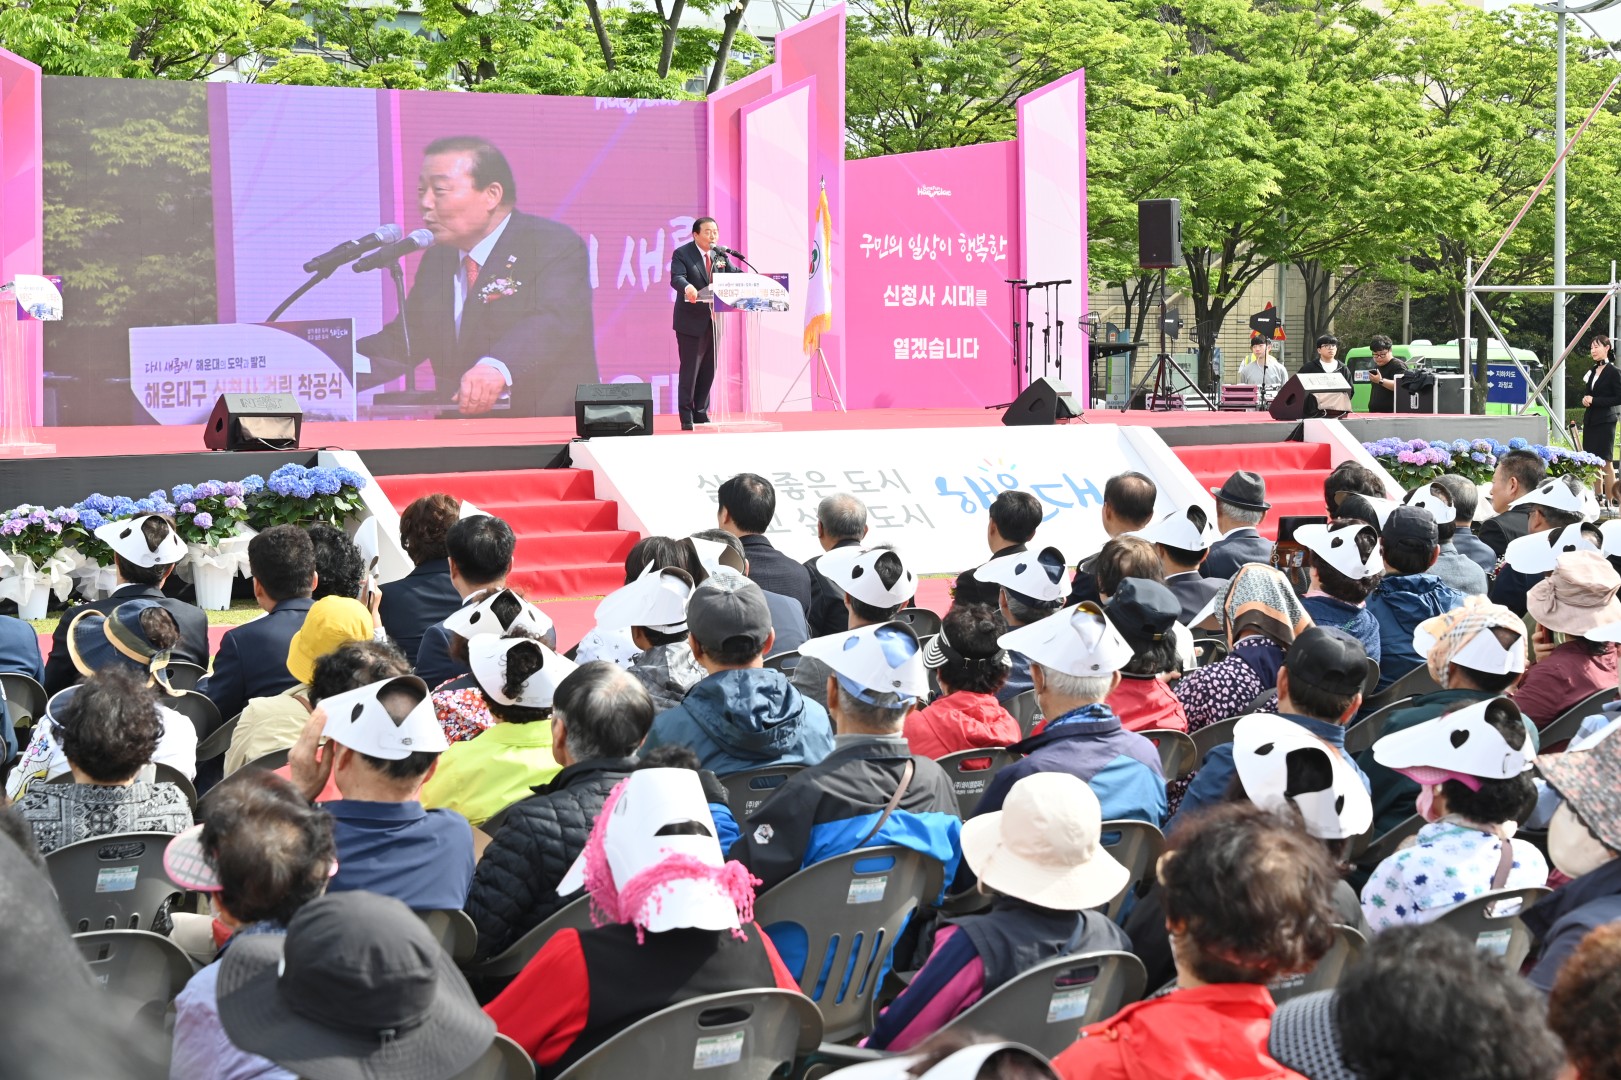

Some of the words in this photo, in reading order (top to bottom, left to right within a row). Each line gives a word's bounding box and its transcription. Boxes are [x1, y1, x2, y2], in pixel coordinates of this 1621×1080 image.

[859, 233, 903, 259] 구민의
[908, 233, 952, 260] 일상이
[958, 232, 1008, 263] 행복한
[883, 284, 936, 307] 신청사
[941, 284, 988, 307] 시대를
[893, 337, 980, 360] 열겠습니다
[145, 361, 162, 374] 다시
[195, 358, 226, 371] 해운대의
[227, 357, 249, 369] 도약과
[250, 355, 266, 369] 발전
[1495, 370, 1516, 378] 지하차도
[144, 379, 207, 410] 해운대구
[298, 372, 343, 400] 착공식
[772, 470, 837, 500] 좋은
[843, 468, 911, 494] 도시
[867, 503, 936, 529] 도시
